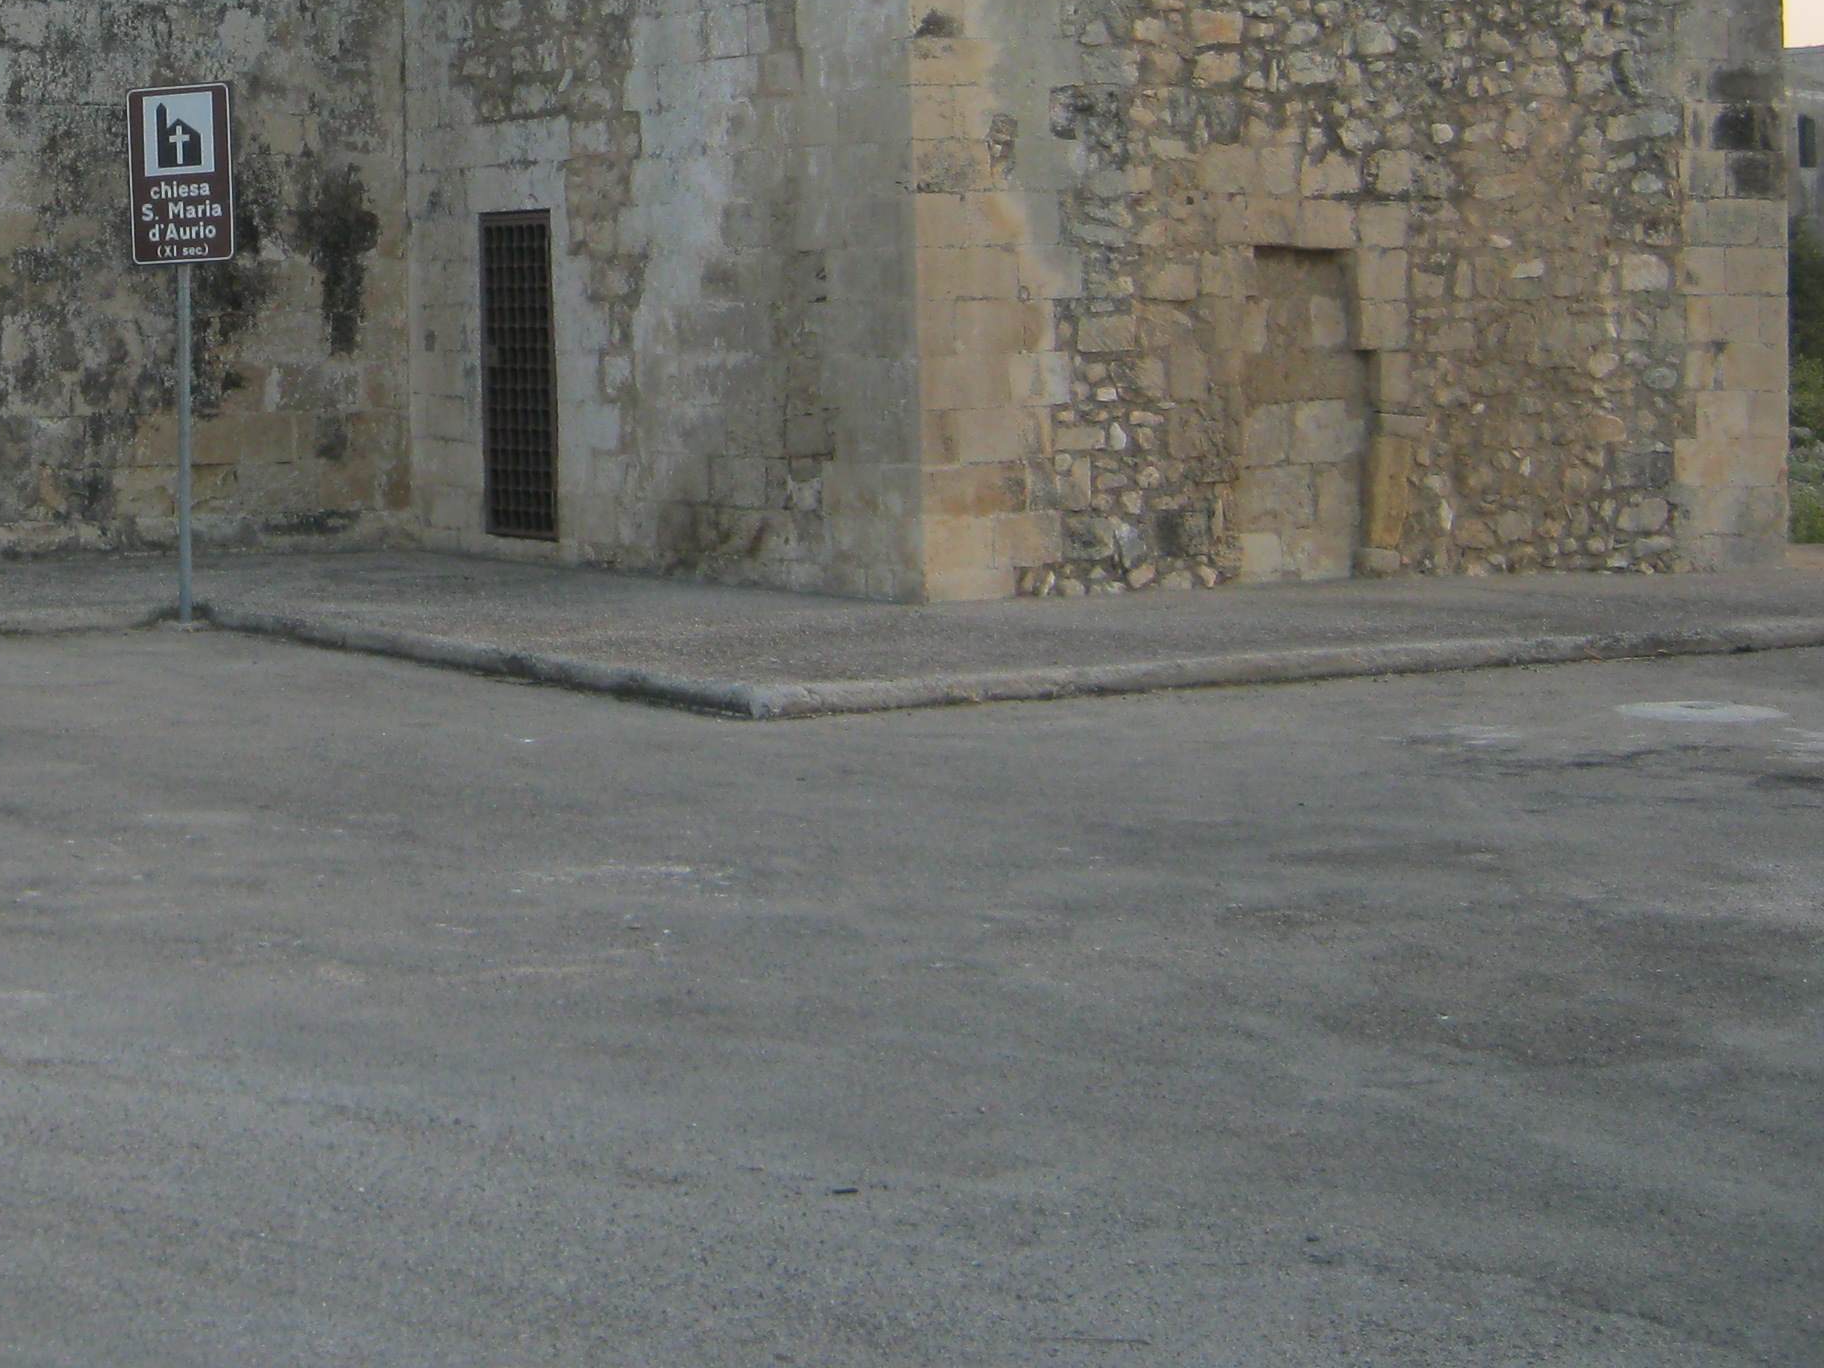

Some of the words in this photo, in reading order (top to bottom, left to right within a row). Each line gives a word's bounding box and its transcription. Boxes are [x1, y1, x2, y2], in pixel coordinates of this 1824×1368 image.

[150, 181, 210, 199] chiesa
[142, 203, 159, 221] S.
[168, 200, 223, 219] Maria
[149, 222, 216, 241] d'Aurio
[157, 244, 177, 257] (XI
